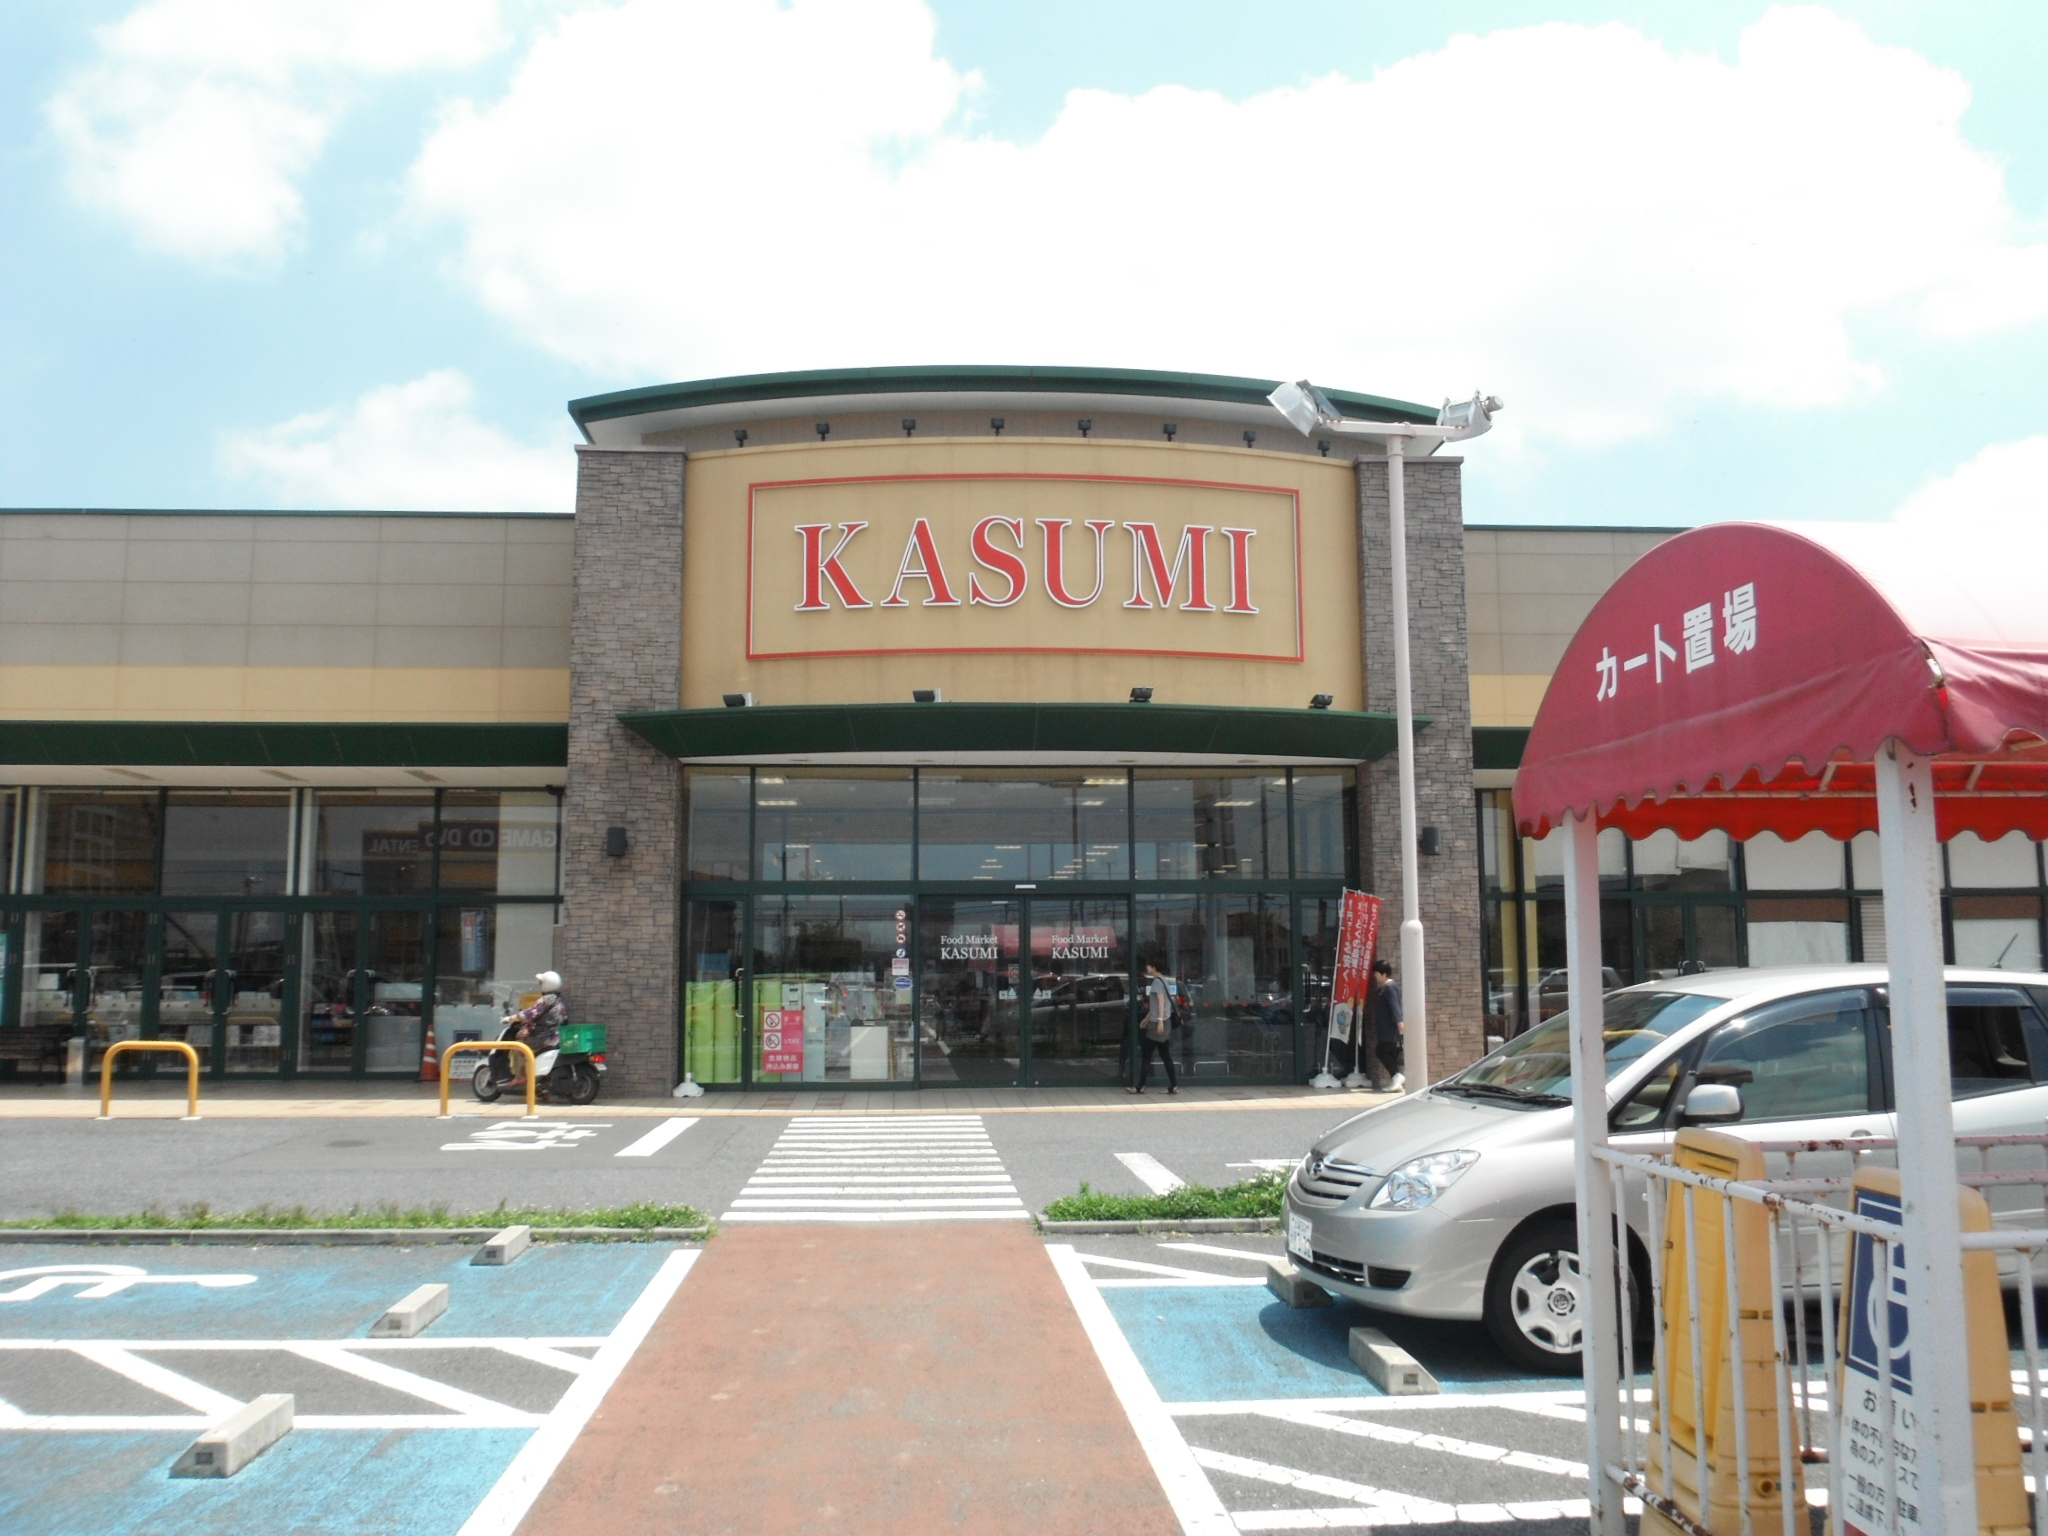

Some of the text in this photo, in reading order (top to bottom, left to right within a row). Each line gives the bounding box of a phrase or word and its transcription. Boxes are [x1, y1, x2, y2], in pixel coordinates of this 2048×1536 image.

[794, 515, 1259, 614] KASUMI
[1596, 582, 1757, 702] カート置場
[940, 935, 999, 945] Food Market
[1052, 934, 1108, 944] Food Market
[940, 947, 999, 959] KASUMI
[1052, 946, 1109, 959] KASUMI
